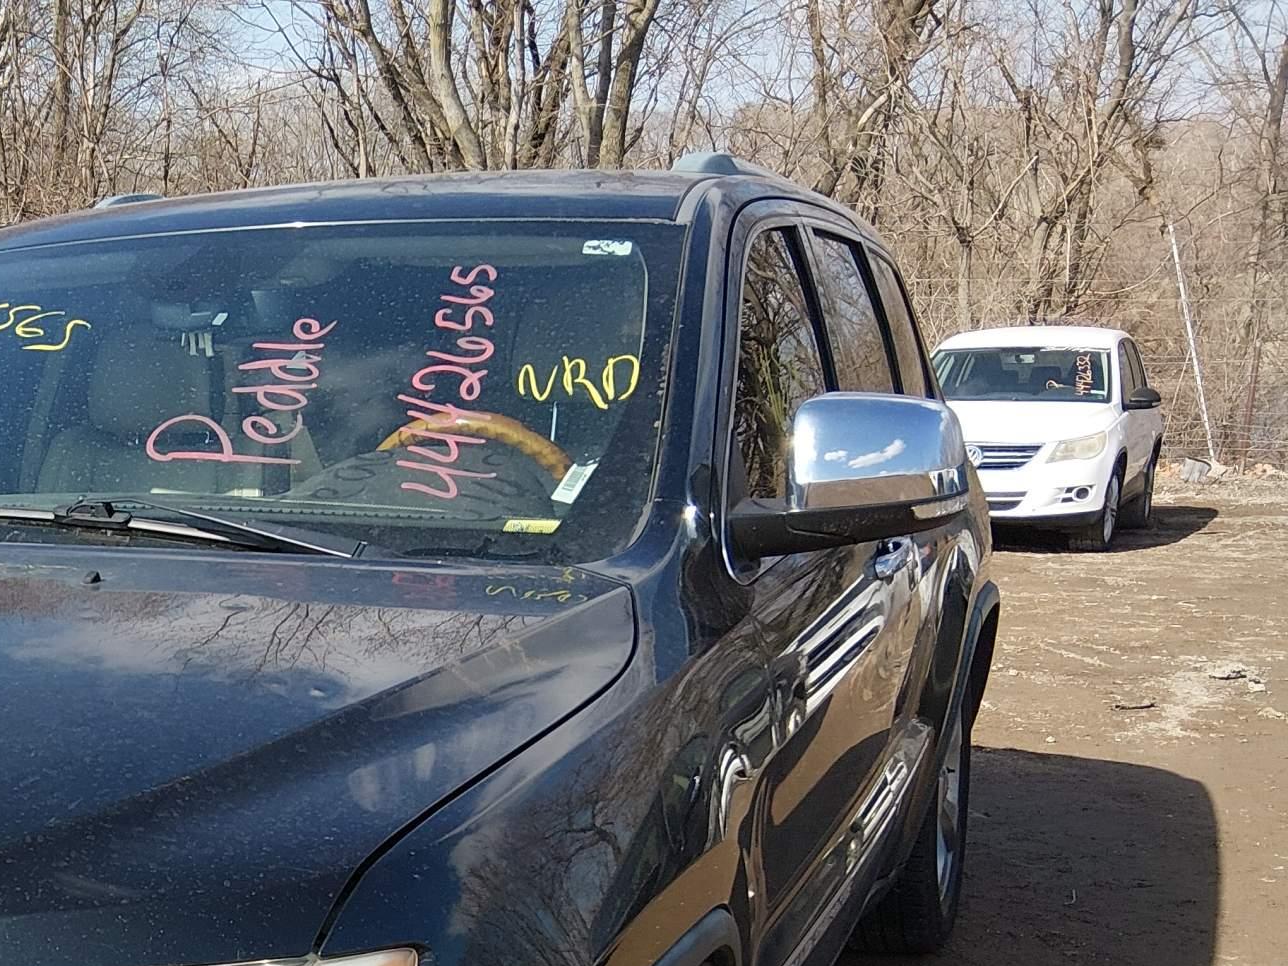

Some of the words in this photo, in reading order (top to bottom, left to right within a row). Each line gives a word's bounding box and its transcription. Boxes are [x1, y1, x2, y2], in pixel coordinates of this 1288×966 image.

[145, 317, 339, 465] Peddle
[395, 263, 499, 500] 44426565
[517, 354, 641, 410] NRD
